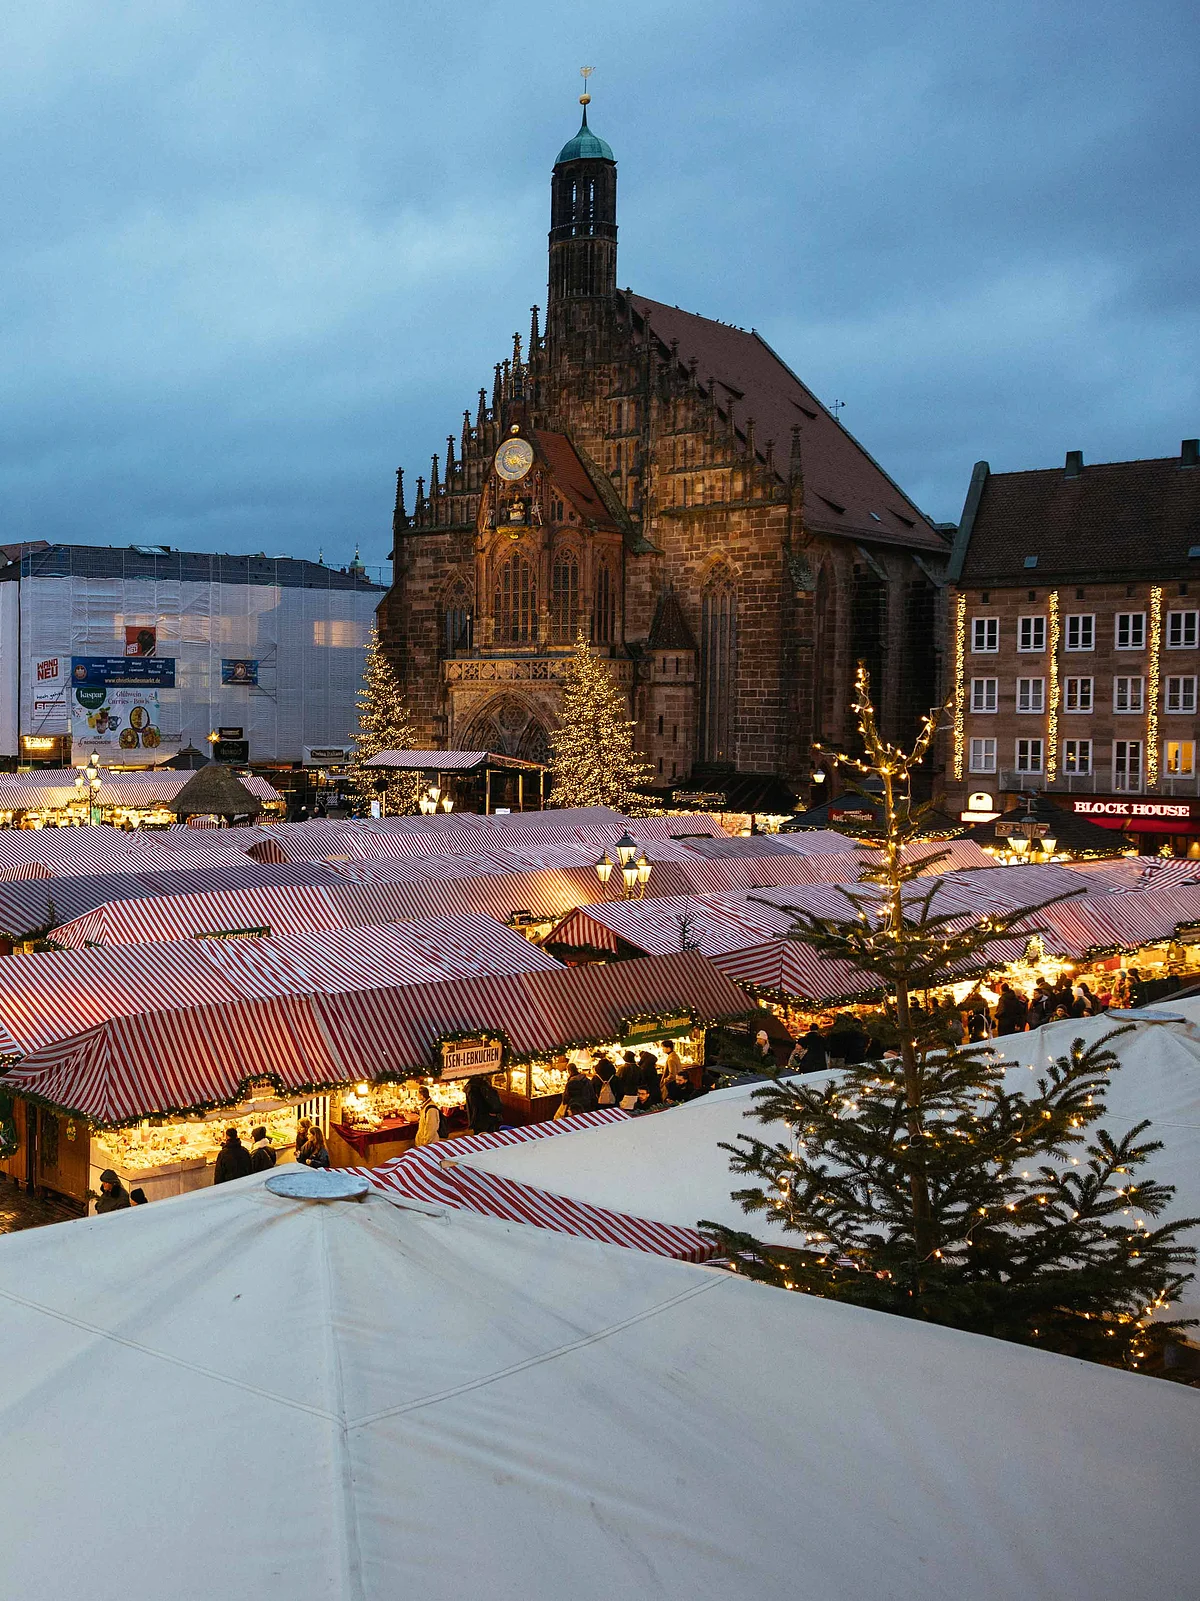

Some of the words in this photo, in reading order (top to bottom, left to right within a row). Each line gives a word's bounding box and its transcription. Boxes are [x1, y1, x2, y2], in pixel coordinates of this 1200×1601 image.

[37, 658, 58, 670] WAND
[37, 666, 58, 681] NEU
[80, 690, 104, 699] kaspar
[1073, 801, 1130, 815] BLOCK
[1130, 803, 1190, 817] HOUSE
[444, 1047, 499, 1069] ISEN-LEBKUCHEN
